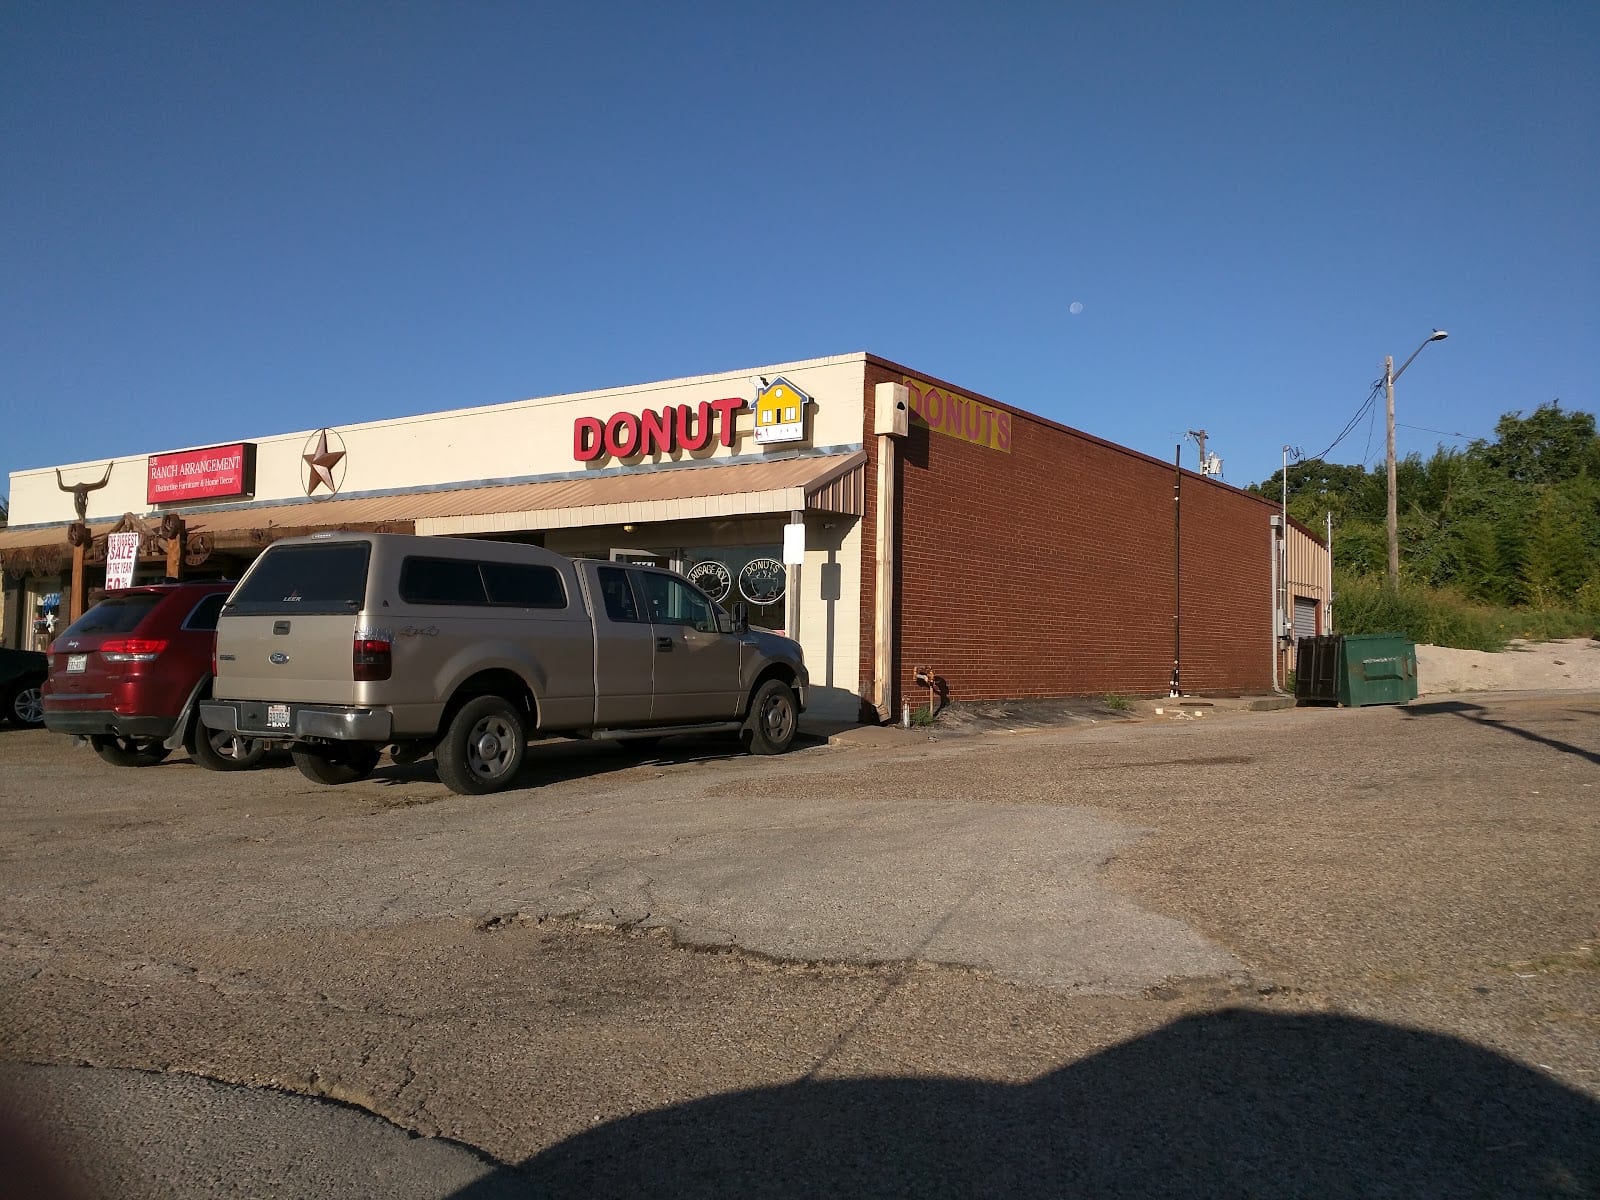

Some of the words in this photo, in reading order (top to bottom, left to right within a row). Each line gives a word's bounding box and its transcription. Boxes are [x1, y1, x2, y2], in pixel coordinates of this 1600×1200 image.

[904, 380, 1010, 449] DONUTS
[574, 397, 745, 461] DONUT
[151, 464, 178, 479] RANCH
[179, 455, 241, 476] ARRANGEMENT
[205, 478, 219, 487] Home
[110, 545, 134, 560] SALE
[690, 564, 716, 584] AUSAGE
[745, 560, 781, 577] DONUTS
